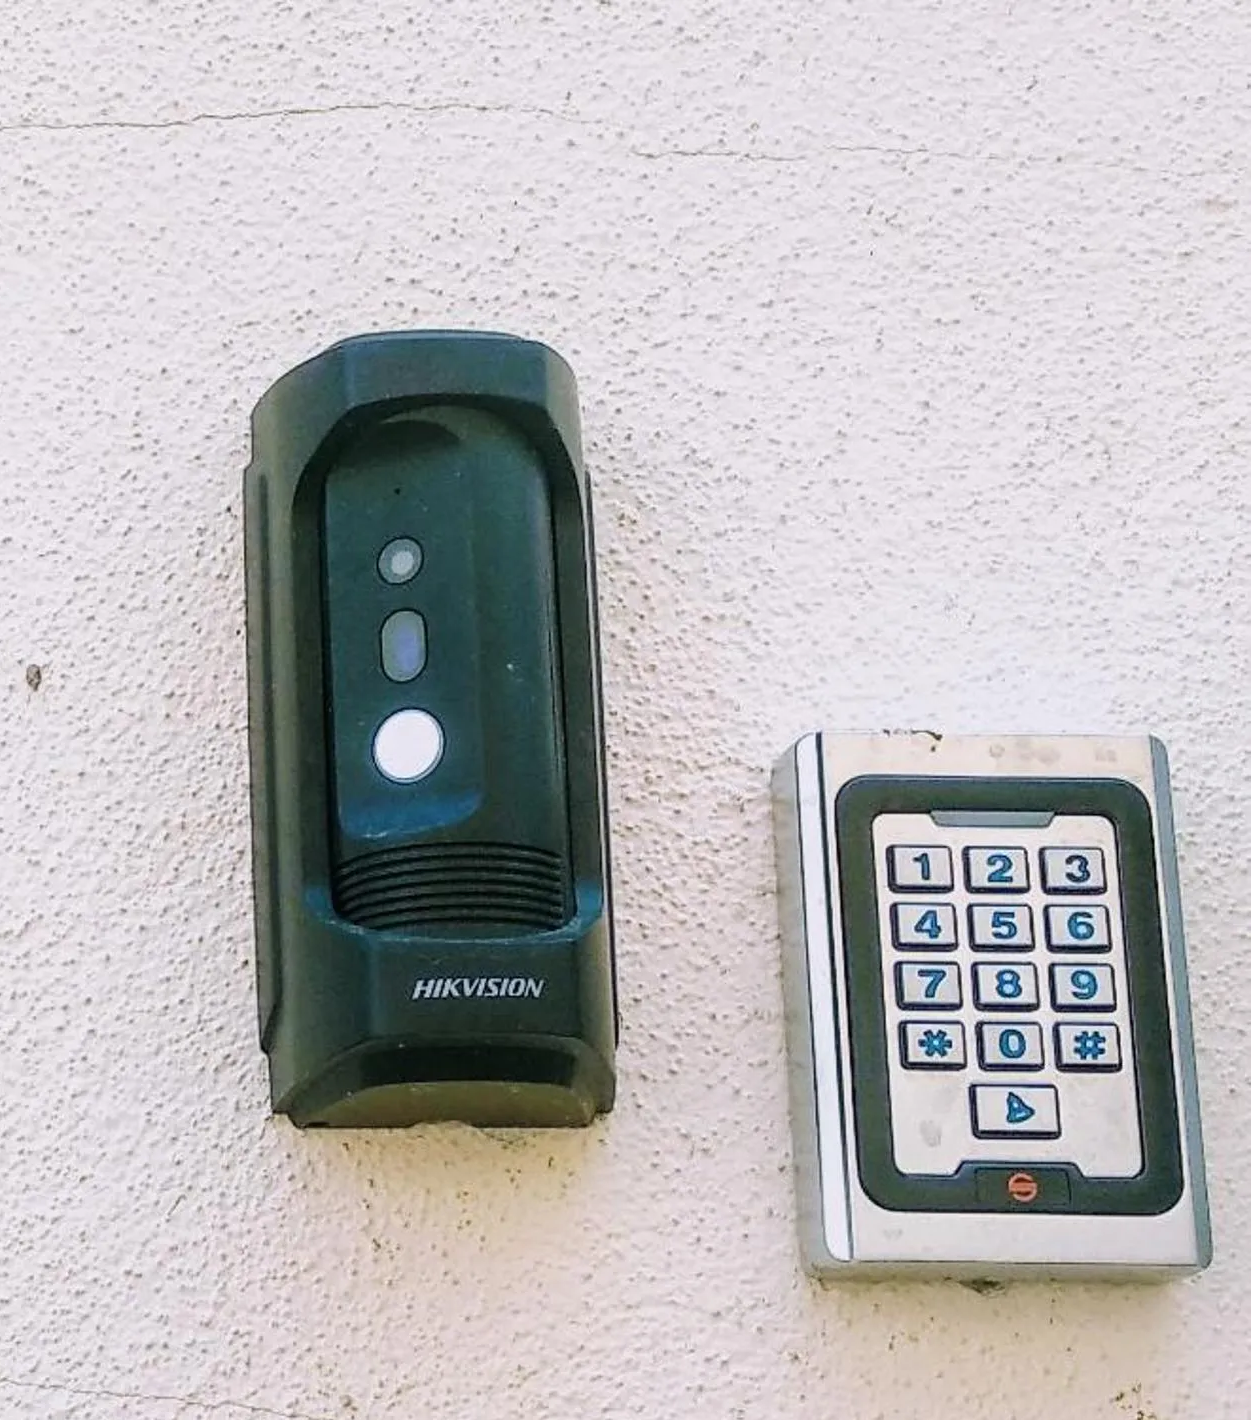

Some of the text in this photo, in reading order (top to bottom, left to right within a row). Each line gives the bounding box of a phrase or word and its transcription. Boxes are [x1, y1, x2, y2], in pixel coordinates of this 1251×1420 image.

[913, 852, 1091, 883] 1 2 3
[914, 910, 1095, 940] 4 5 6
[411, 977, 545, 1000] HIKVISION
[917, 969, 1098, 1000] 7 8 9
[998, 1029, 1026, 1059] 0
